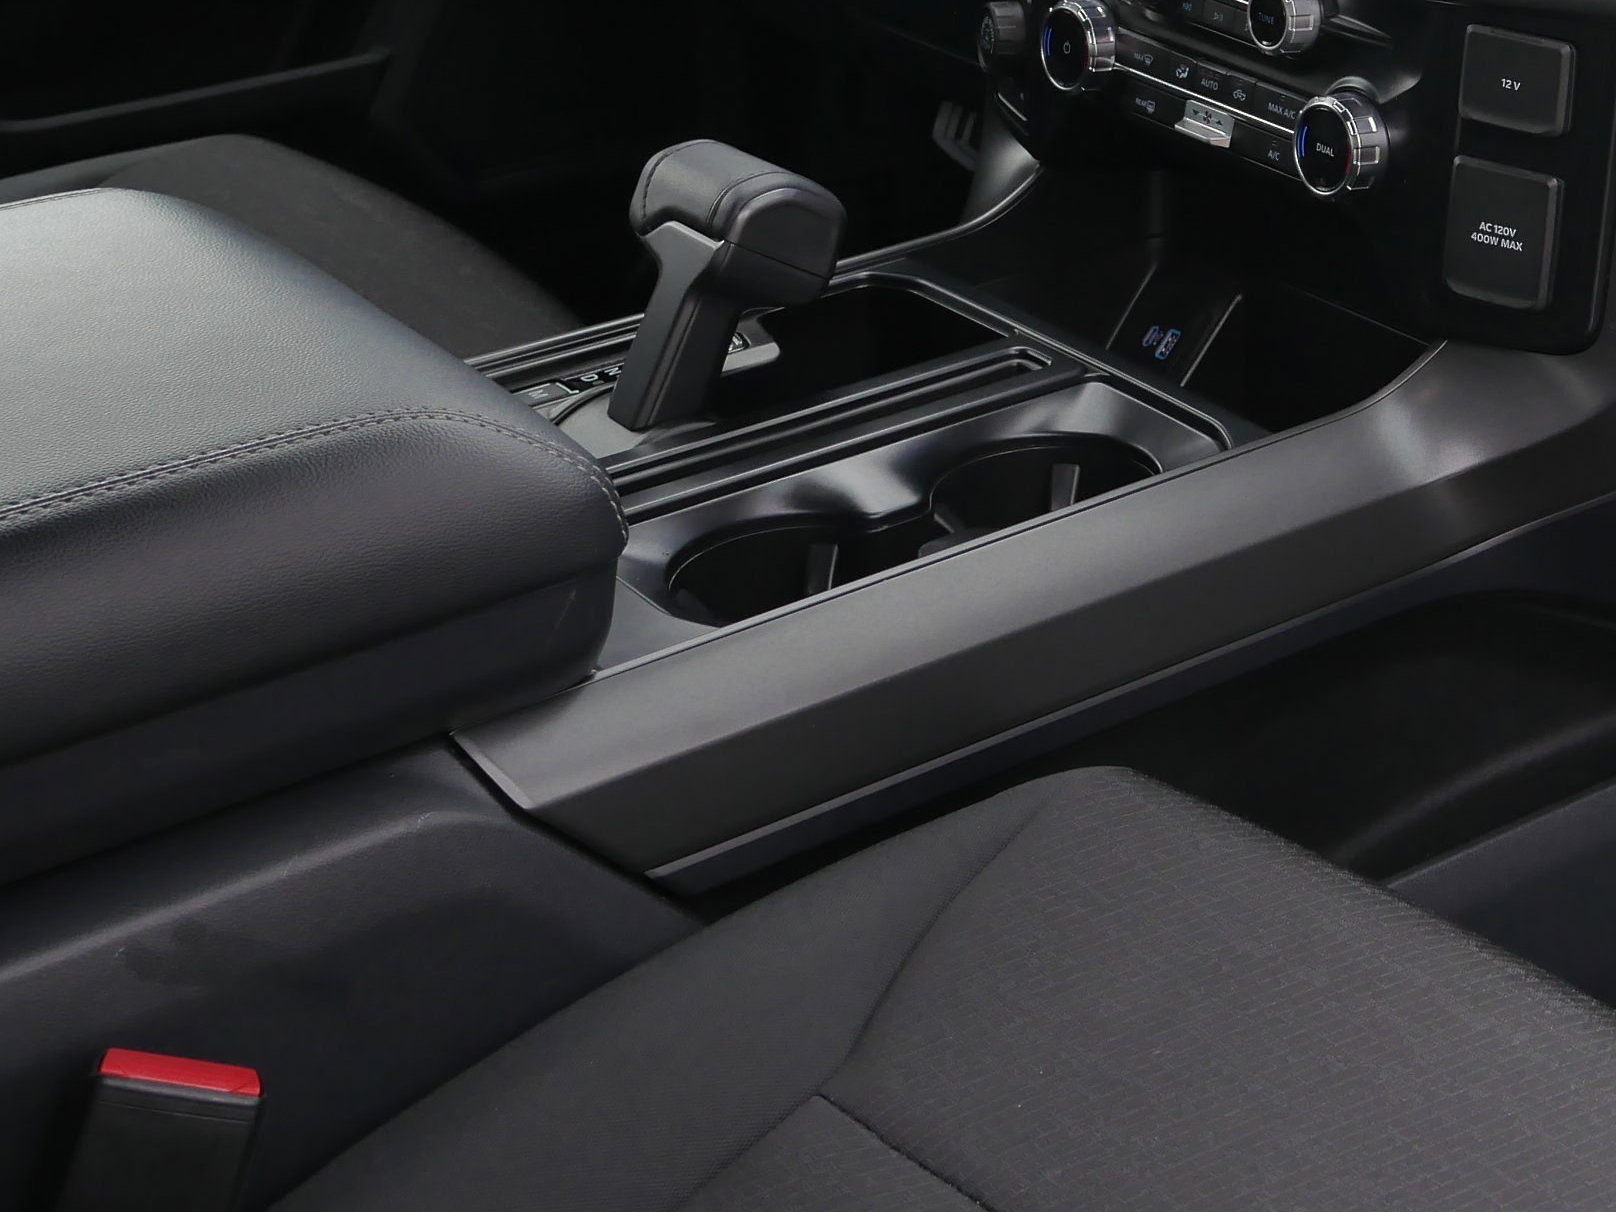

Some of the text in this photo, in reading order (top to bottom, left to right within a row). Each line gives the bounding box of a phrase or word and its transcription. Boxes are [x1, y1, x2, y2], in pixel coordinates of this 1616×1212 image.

[1257, 12, 1275, 25] TUNE
[1200, 78, 1219, 91] AUTO
[1500, 78, 1521, 91] 12 V
[1267, 101, 1296, 119] MAX A/C
[1267, 149, 1280, 162] A/C
[1316, 142, 1335, 157] DUAL
[1479, 221, 1517, 238] AC 120V
[1470, 231, 1523, 252] 400W MAX
[580, 373, 599, 382] D
[604, 366, 622, 376] N
